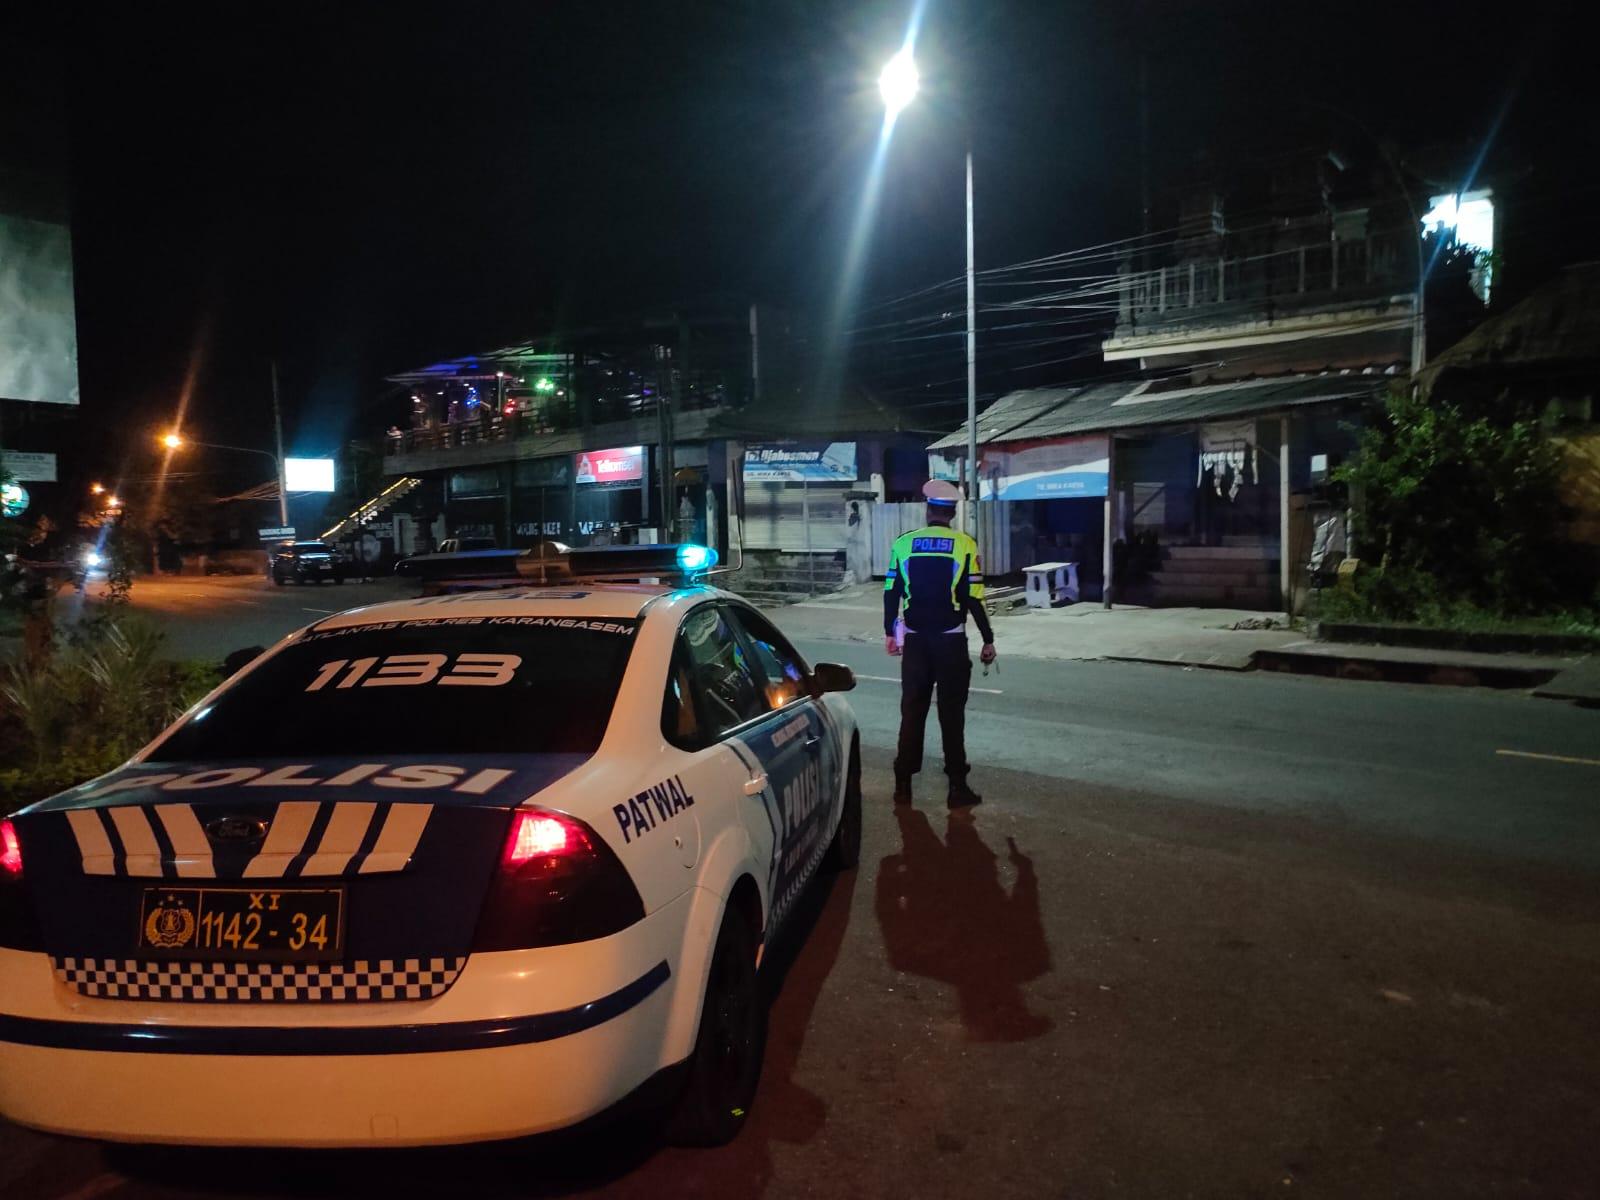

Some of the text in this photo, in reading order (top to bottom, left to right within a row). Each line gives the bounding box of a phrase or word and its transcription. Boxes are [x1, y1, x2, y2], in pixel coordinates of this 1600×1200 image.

[912, 538, 954, 553] POLISI
[296, 616, 636, 644] ATLANTAS POLRES KARANGASEM
[303, 652, 523, 693] 1133
[71, 762, 517, 802] POLISI
[783, 760, 820, 839] POLISI
[612, 774, 696, 844] PATWAL
